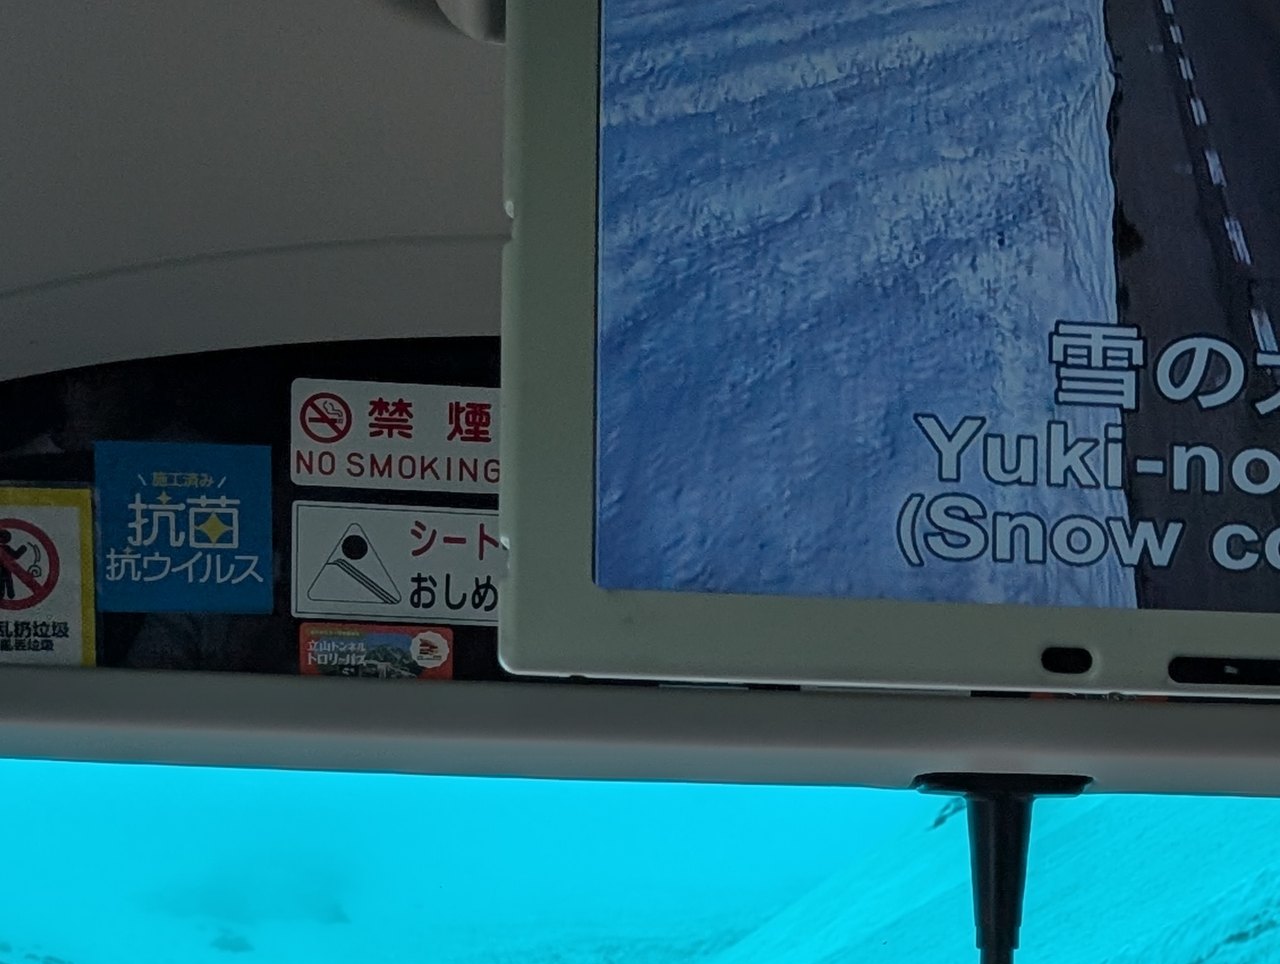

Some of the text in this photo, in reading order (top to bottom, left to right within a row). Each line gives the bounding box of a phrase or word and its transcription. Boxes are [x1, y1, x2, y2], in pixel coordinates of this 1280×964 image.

[368, 397, 493, 443] 禁煙
[151, 471, 215, 489] 施工済み
[295, 450, 500, 484] NO SMOKING
[127, 492, 241, 549] 抗菌
[410, 520, 500, 562] シート
[896, 492, 1185, 570] (Snow
[105, 547, 265, 585] 抗ウイルス
[408, 572, 500, 612] おしめ
